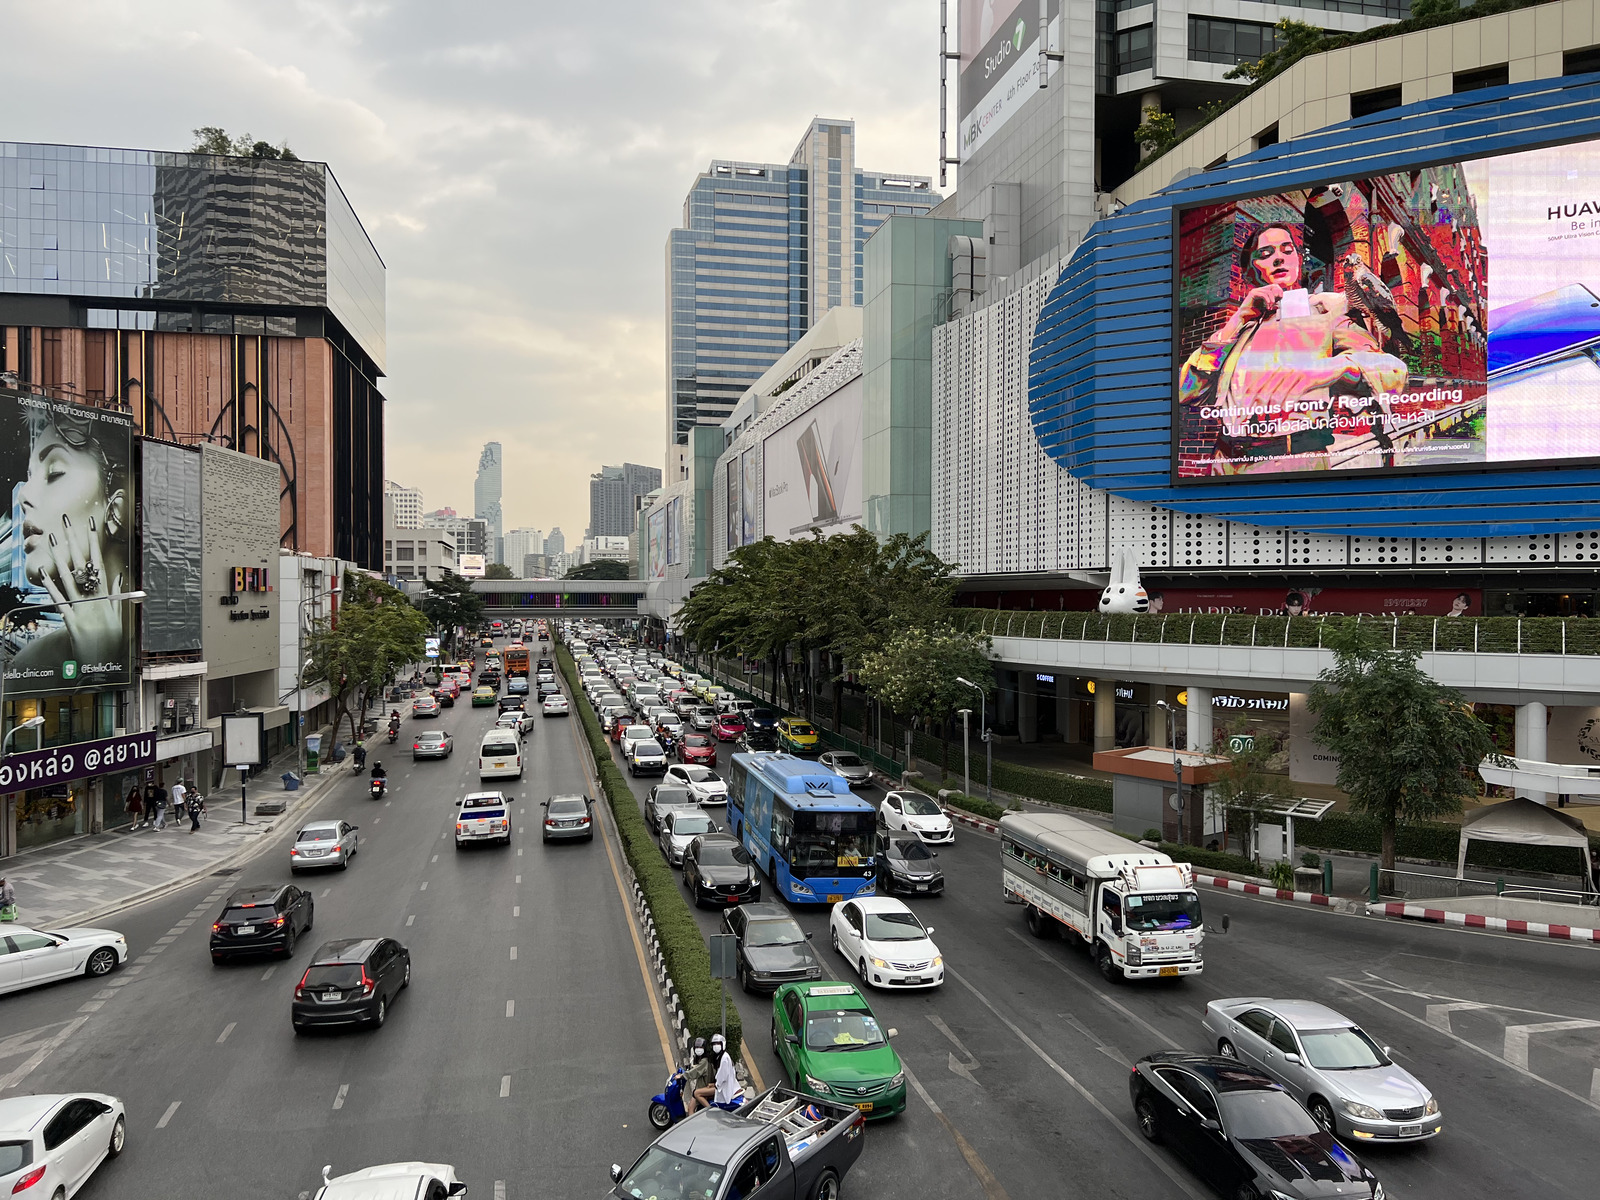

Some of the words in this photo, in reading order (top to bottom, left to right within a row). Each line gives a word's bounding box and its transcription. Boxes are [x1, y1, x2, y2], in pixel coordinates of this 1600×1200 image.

[984, 40, 1011, 79] Studio
[963, 116, 983, 150] MBK
[981, 99, 1003, 128] CENTER
[1006, 85, 1016, 102] 4th
[1016, 71, 1031, 93] Floor
[1571, 221, 1586, 231] Be
[1578, 230, 1594, 238] Vision
[1200, 403, 1281, 419] Continuous
[1285, 399, 1325, 413] Front
[1327, 396, 1335, 410] /
[1338, 395, 1374, 409] Rear
[1379, 388, 1463, 406] Recording
[3, 668, 54, 680] stella-clinic.com
[81, 662, 122, 673] @EstellaClinic
[1040, 674, 1054, 683] COFFEE
[84, 739, 152, 771] @สยาม
[1313, 754, 1343, 763] COMING
